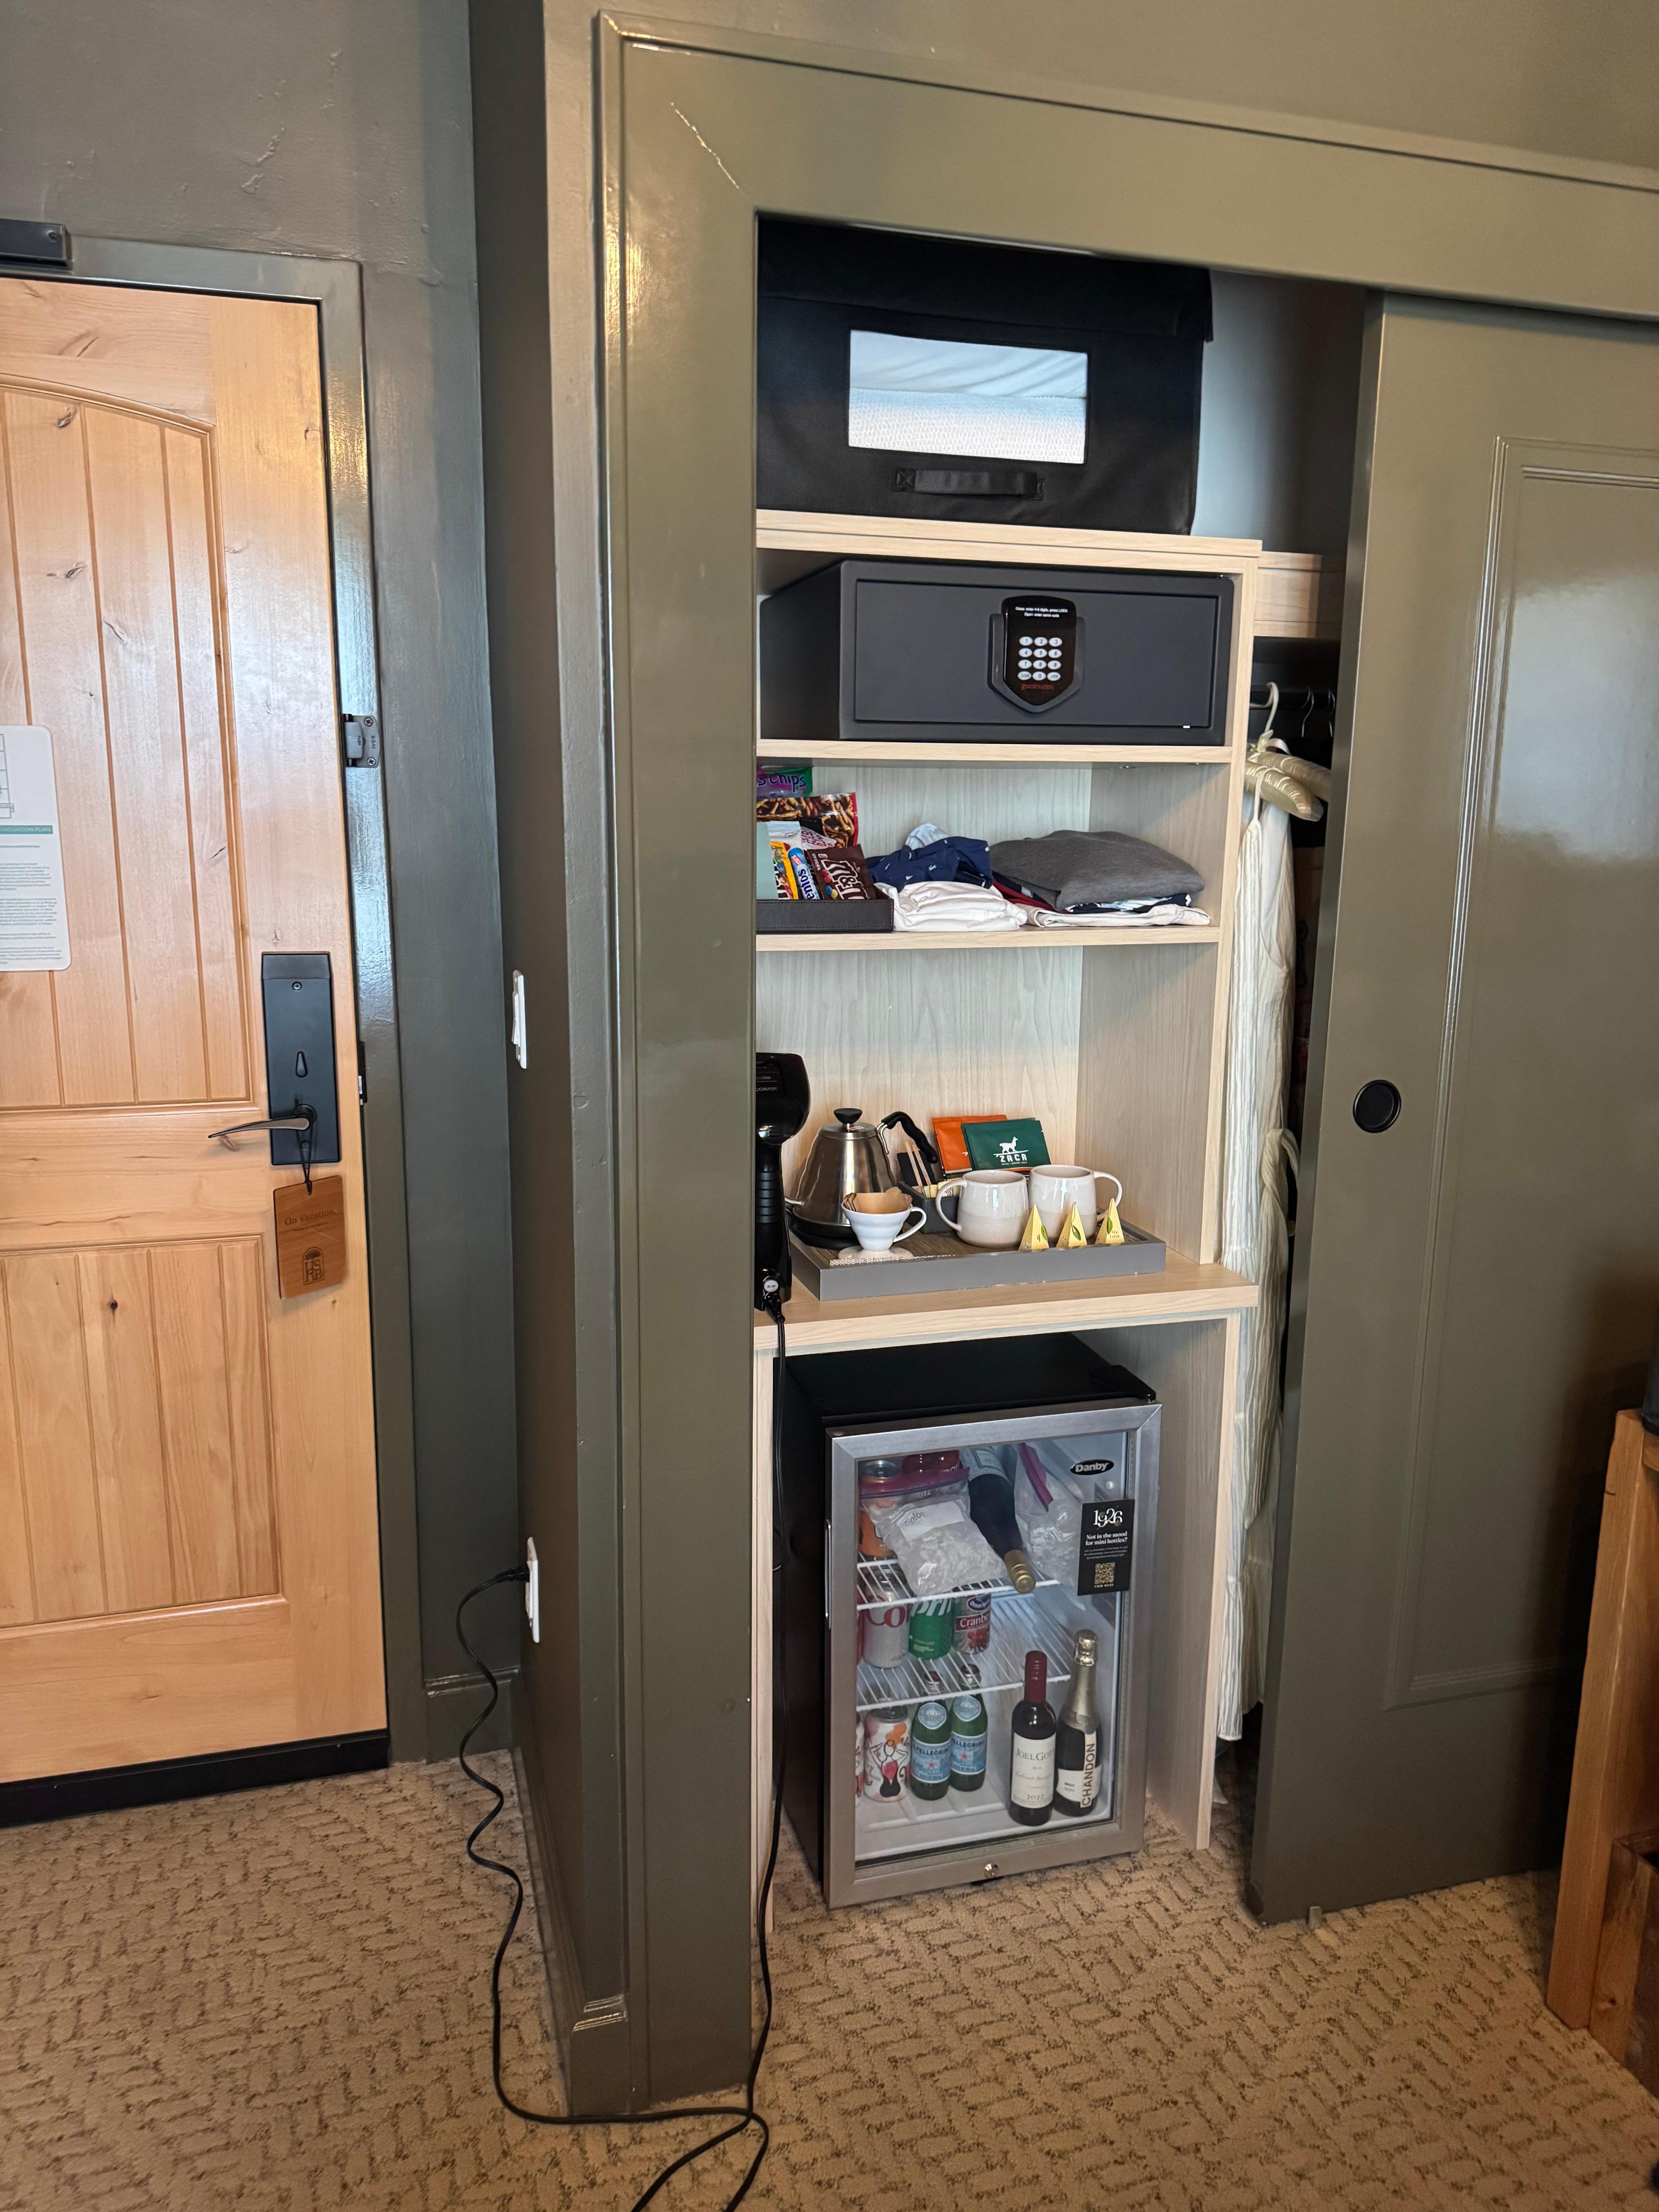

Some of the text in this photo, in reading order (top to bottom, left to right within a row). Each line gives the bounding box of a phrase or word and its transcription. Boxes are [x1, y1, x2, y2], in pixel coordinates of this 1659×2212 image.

[798, 869, 815, 899] entos
[1000, 1154, 1027, 1162] ZACA
[1075, 1462, 1108, 1472] Danby
[1093, 1508, 1123, 1527] 1926
[1015, 1748, 1035, 1760] JOEL
[1082, 1743, 1095, 1806] CHANDON
